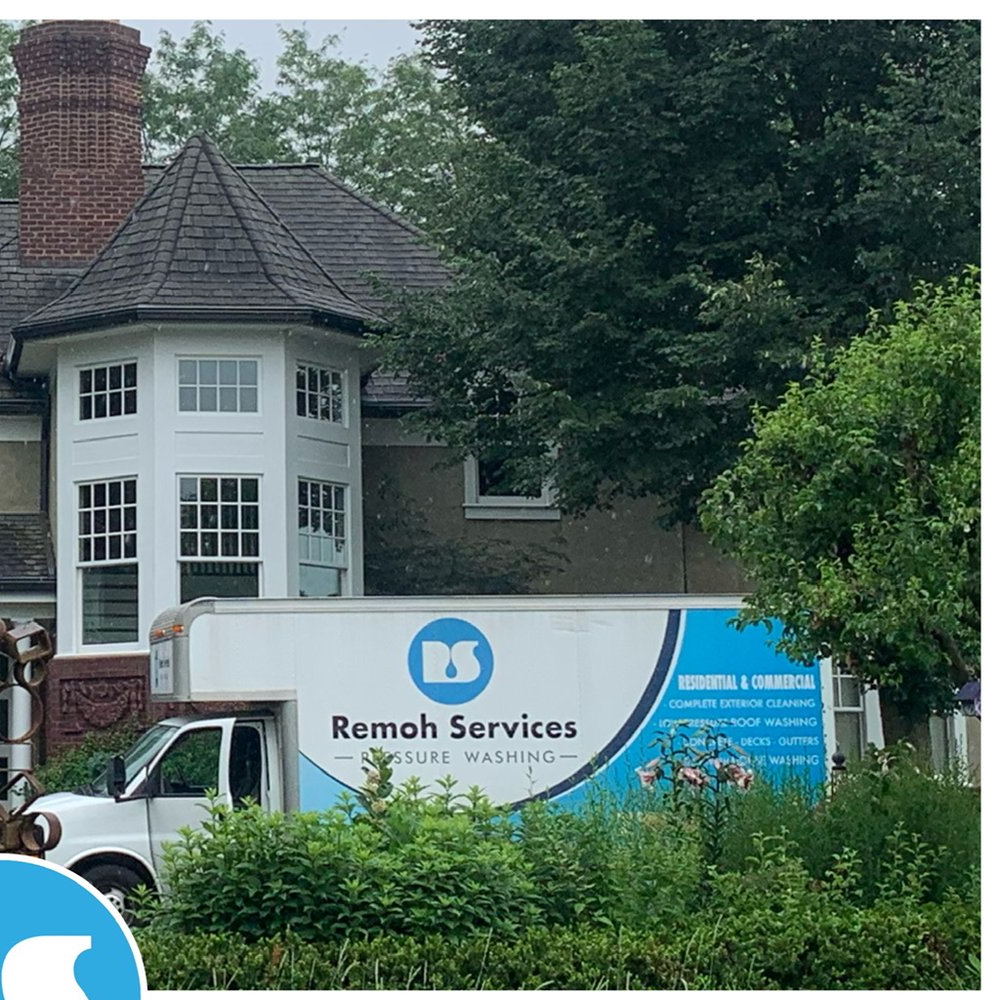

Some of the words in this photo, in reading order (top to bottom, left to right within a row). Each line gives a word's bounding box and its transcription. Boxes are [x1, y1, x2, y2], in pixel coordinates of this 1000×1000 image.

[678, 674, 738, 690] RESIDENTIAL
[740, 675, 749, 690] &
[751, 674, 816, 690] COMMERCIAL
[669, 699, 717, 709] COMPLETE
[719, 699, 763, 708] EXTERIOR
[766, 699, 816, 708] CLEANING
[331, 713, 438, 739] Remoh
[449, 713, 578, 739] Services
[731, 717, 761, 727] ROOF
[764, 717, 818, 727] WASHING
[740, 736, 771, 746] DECKS
[778, 736, 820, 746] GUTTERS
[361, 751, 450, 764] PSSURE
[464, 750, 556, 764] WASHING
[769, 755, 820, 765] WASHING
